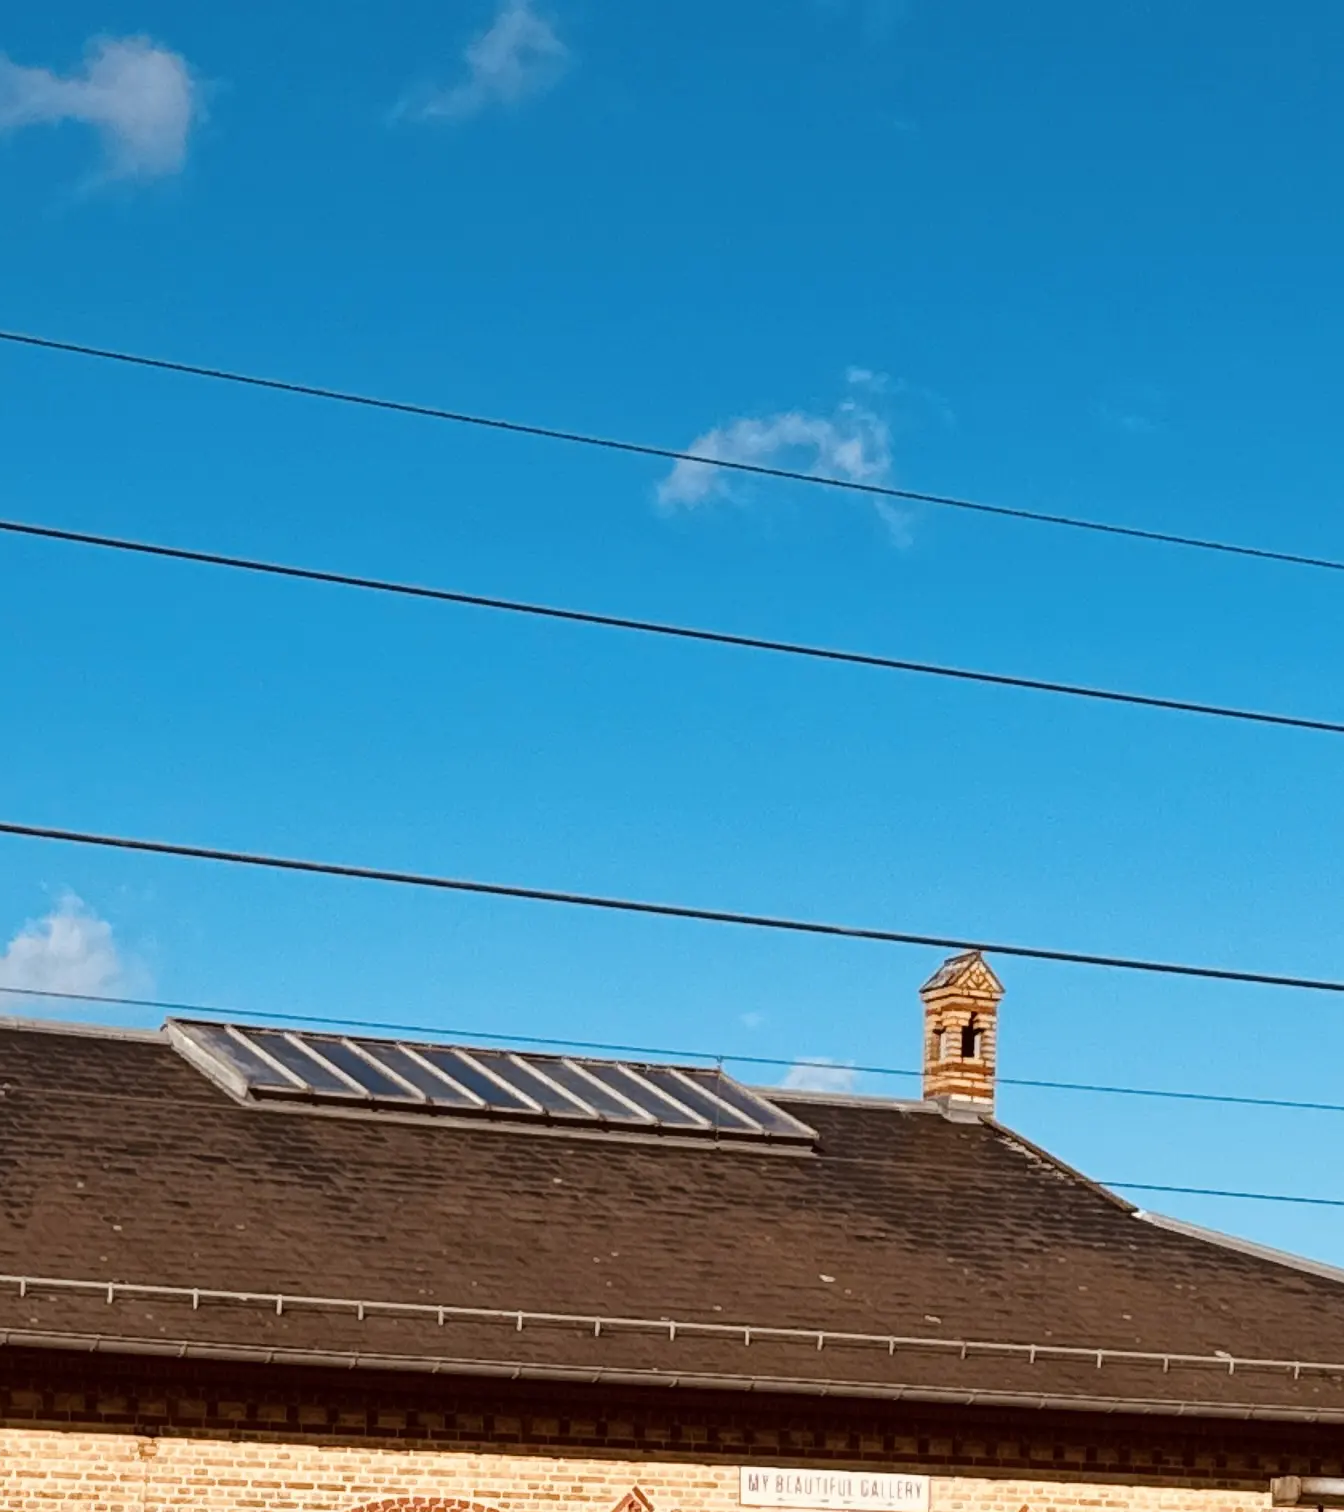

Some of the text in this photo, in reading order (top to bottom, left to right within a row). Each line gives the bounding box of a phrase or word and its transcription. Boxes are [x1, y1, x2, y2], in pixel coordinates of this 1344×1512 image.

[748, 1472, 923, 1499] MY BEAUTIFUL GALLERY
